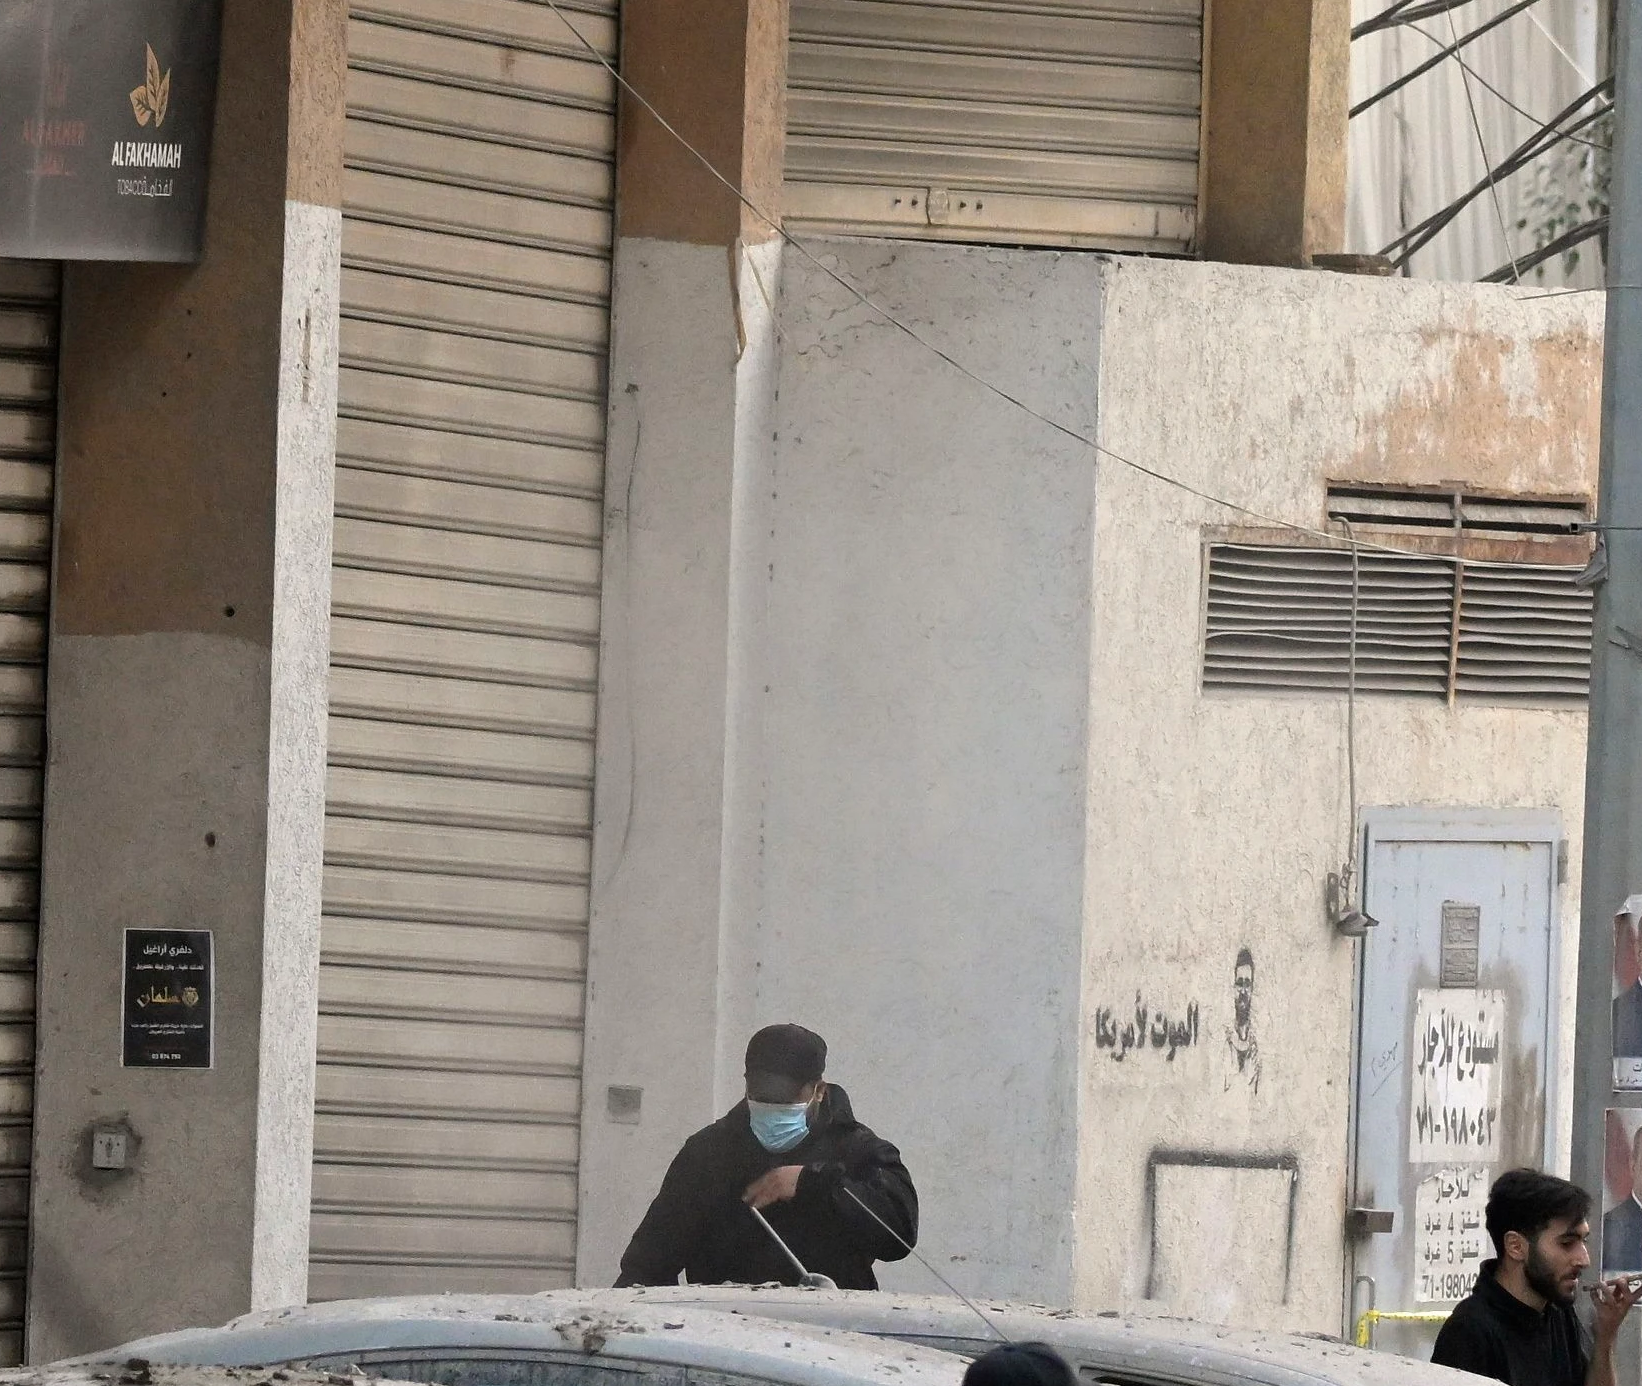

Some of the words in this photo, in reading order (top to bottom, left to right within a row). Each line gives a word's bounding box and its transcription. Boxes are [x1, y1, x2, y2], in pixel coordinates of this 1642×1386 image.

[1458, 1010, 1499, 1082] مستودع
[1448, 1211, 1454, 1235] 4
[1447, 1241, 1454, 1264] 5
